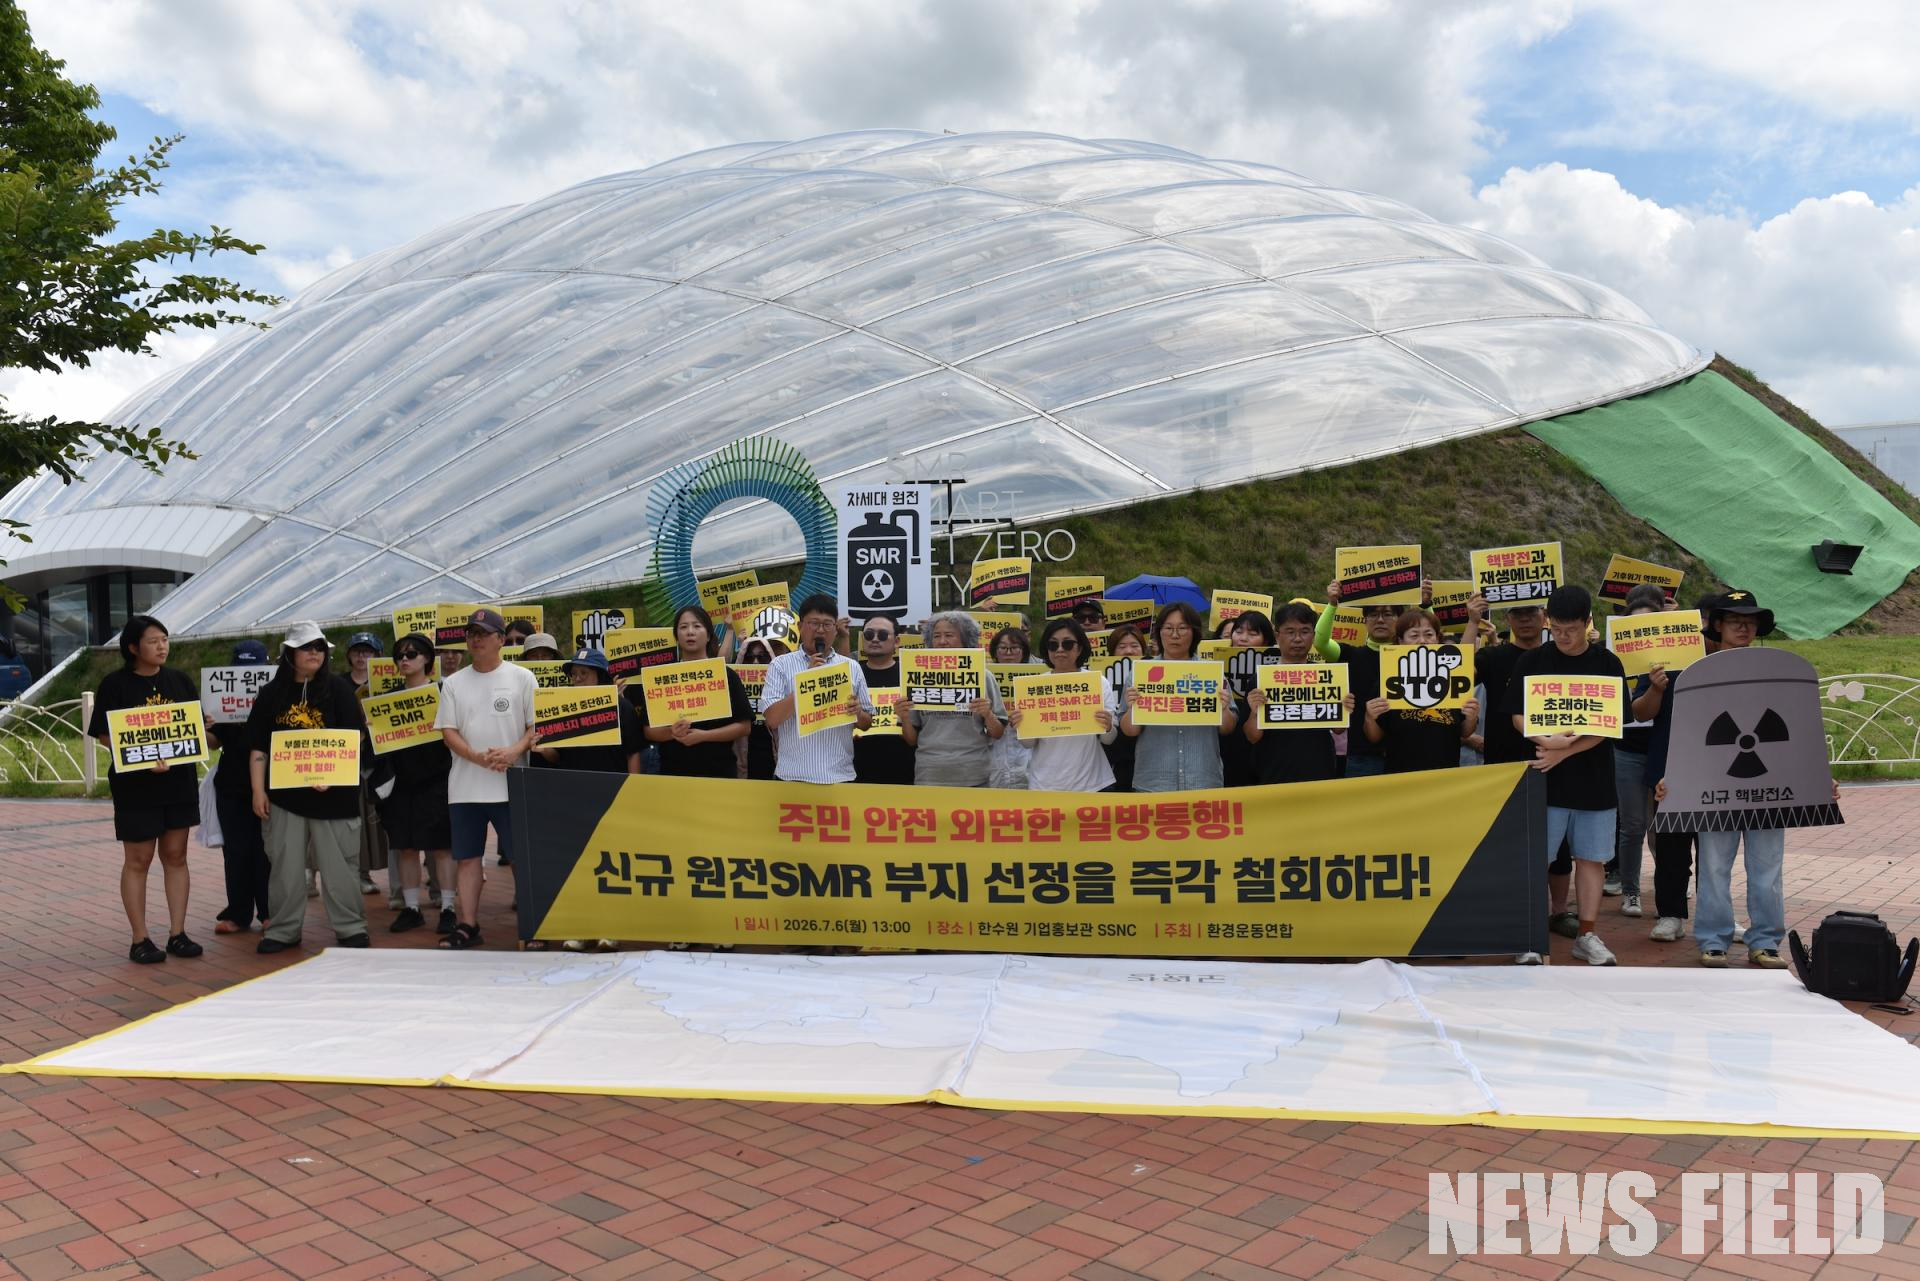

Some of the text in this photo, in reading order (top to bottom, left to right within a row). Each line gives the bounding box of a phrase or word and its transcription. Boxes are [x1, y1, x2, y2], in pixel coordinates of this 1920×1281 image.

[848, 491, 919, 507] 차세대 원전
[856, 547, 901, 565] SMR
[1487, 550, 1545, 567] 핵발전과
[1343, 556, 1410, 576] 기후위기 역행하는
[1479, 565, 1555, 584] 재생에너지
[703, 578, 754, 597] 신규 핵발전소
[1485, 581, 1553, 602] 공존불가!
[397, 613, 413, 624] 신규
[1615, 624, 1698, 640] 지역 불평등 초래하는
[610, 638, 668, 656] 기후위기 역행하는
[1616, 639, 1653, 653] 핵발전소
[1656, 637, 1675, 647] 그만
[372, 665, 395, 676] 지역
[915, 655, 972, 670] 핵발전과
[209, 671, 238, 693] 신규
[654, 669, 714, 685] 부풀린 전력수요
[799, 672, 849, 694] 신규 핵발전소
[907, 671, 979, 686] 재생에너지
[1273, 670, 1333, 685] 핵발전과
[647, 688, 663, 699] 신규
[707, 679, 726, 691] 건설
[1027, 682, 1089, 696] 부풀린 전력수요
[1137, 683, 1175, 694] 국민의힘
[1176, 680, 1218, 694] 민주당
[1265, 687, 1341, 702] 재생에너지
[1385, 676, 1471, 699] STOP
[1531, 683, 1616, 699] 지역 불평등
[370, 694, 437, 717] 신규 핵발전소
[667, 697, 707, 710] 계획 철회!
[813, 689, 838, 707] SMR
[1018, 699, 1036, 710] 신규
[1083, 694, 1101, 705] 건설
[1543, 698, 1604, 712] 초래하는
[535, 695, 613, 719] 핵산업 육성 중단하고
[1269, 703, 1338, 720] 공존불가!
[125, 708, 187, 728] 핵발전과
[390, 710, 425, 727] SMR
[1040, 712, 1058, 722] 계획
[118, 723, 197, 745] 재생에너지
[375, 727, 416, 745] 어디에도
[126, 739, 197, 763] 공존불가!
[312, 739, 346, 748] 전력수요
[273, 750, 292, 761] 신규
[339, 750, 356, 759] 건설
[1701, 787, 1794, 804] 신규 핵발전소
[779, 801, 1244, 843] 주민 안전 외면한 일방통행!
[593, 851, 1432, 904] 신규 원전SMR 부지 선정을 즉각 철회하라!
[744, 917, 1294, 938] 일시 2026.7.6(월) 13:00 장소 한수원 기업홍보관 SSNC 주최 환경운동연합
